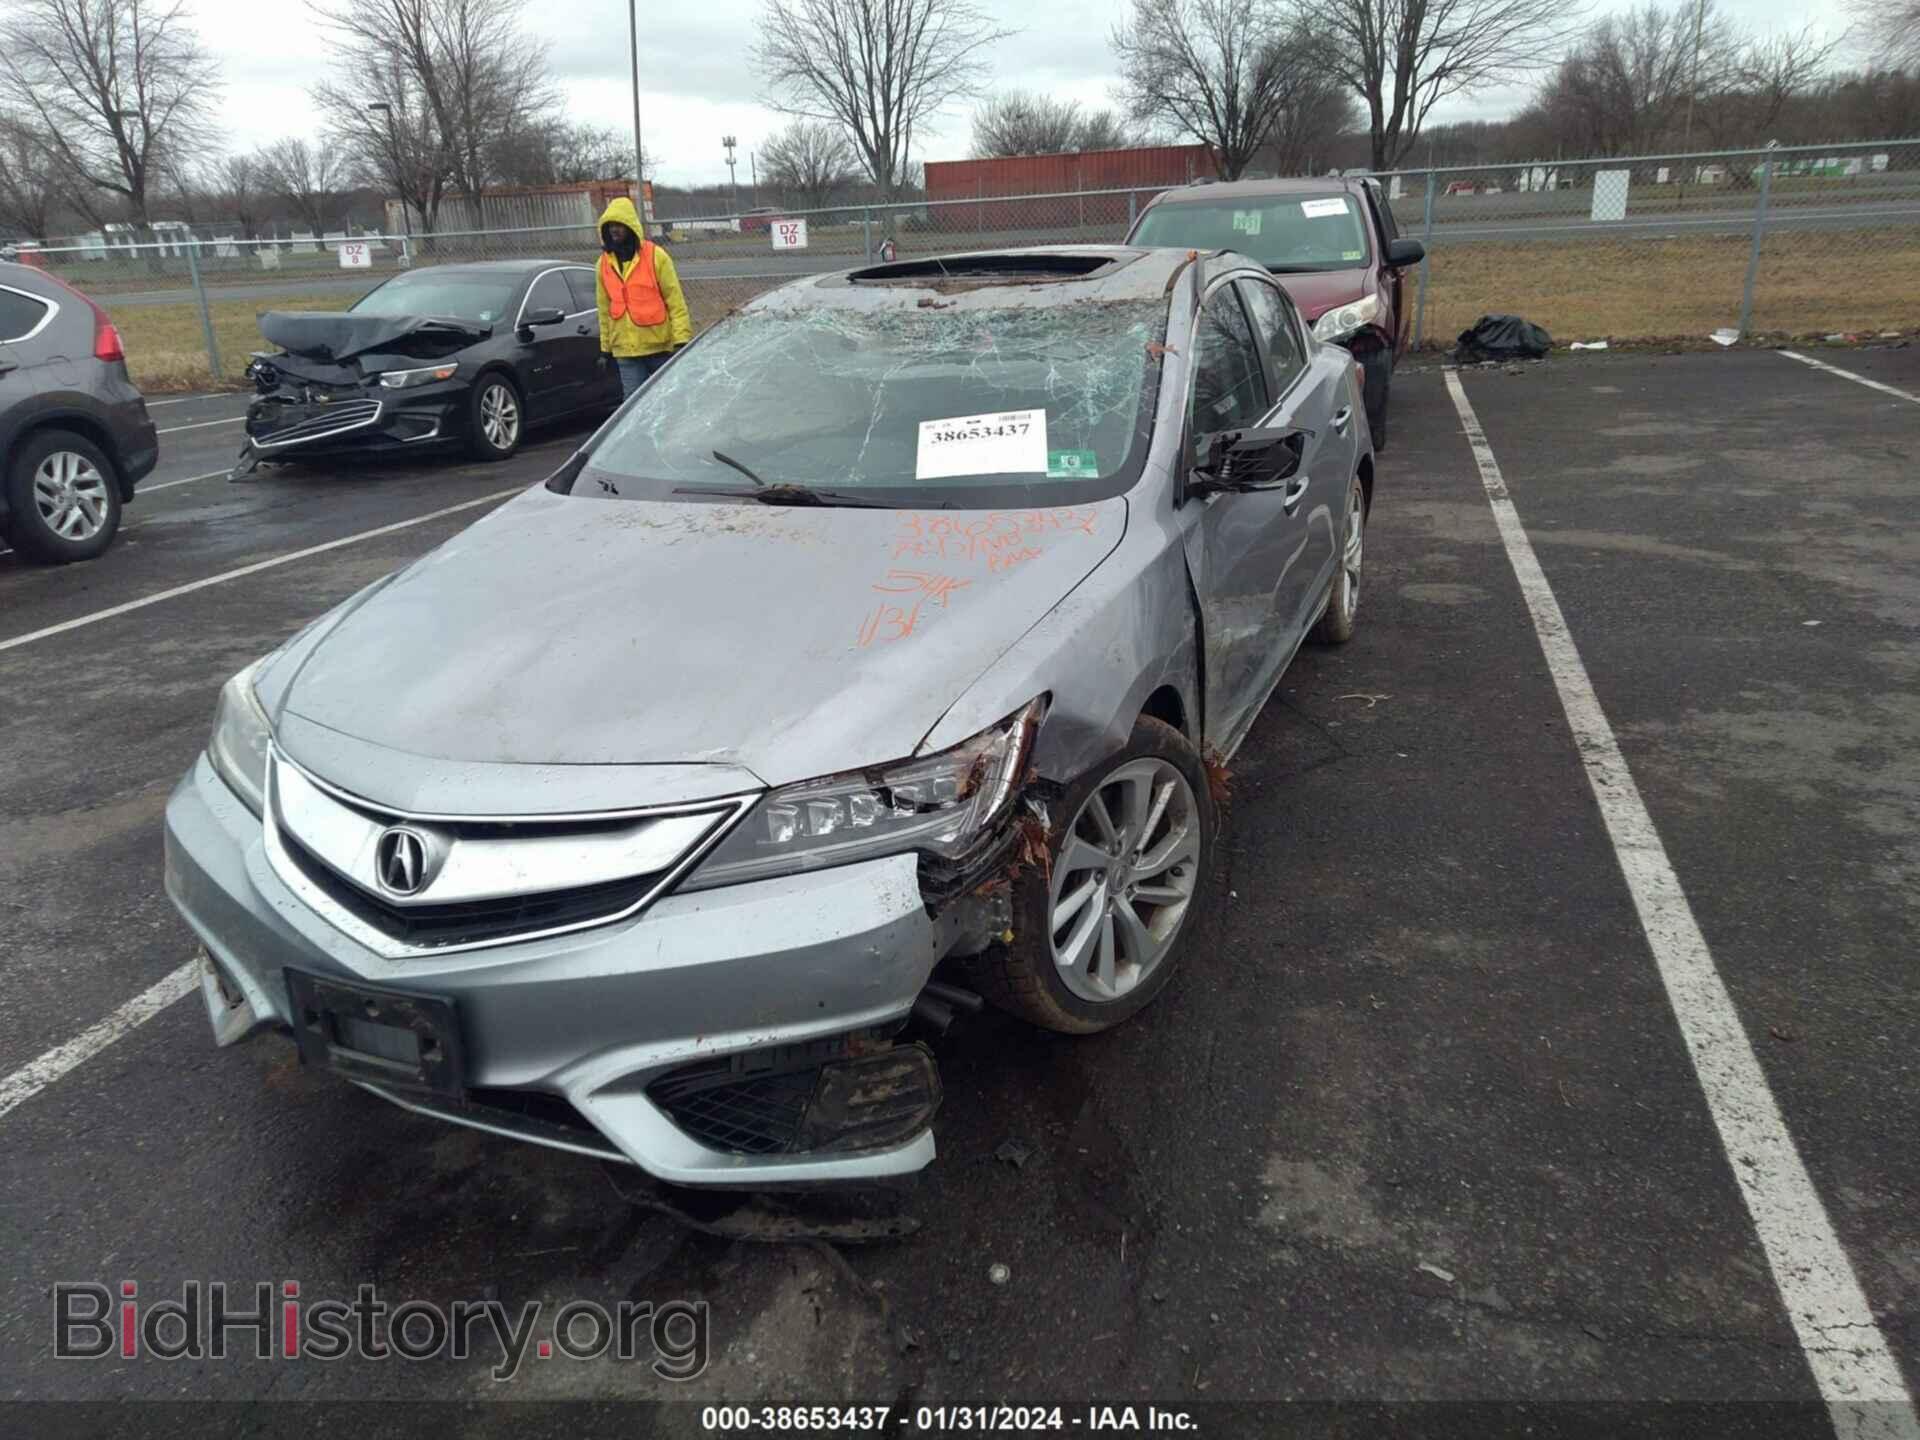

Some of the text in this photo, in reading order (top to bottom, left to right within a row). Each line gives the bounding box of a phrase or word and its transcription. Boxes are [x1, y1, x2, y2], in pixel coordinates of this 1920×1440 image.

[780, 224, 799, 235] DZ
[784, 235, 797, 245] 10
[346, 245, 362, 255] DZ
[931, 423, 1030, 444] 38653437
